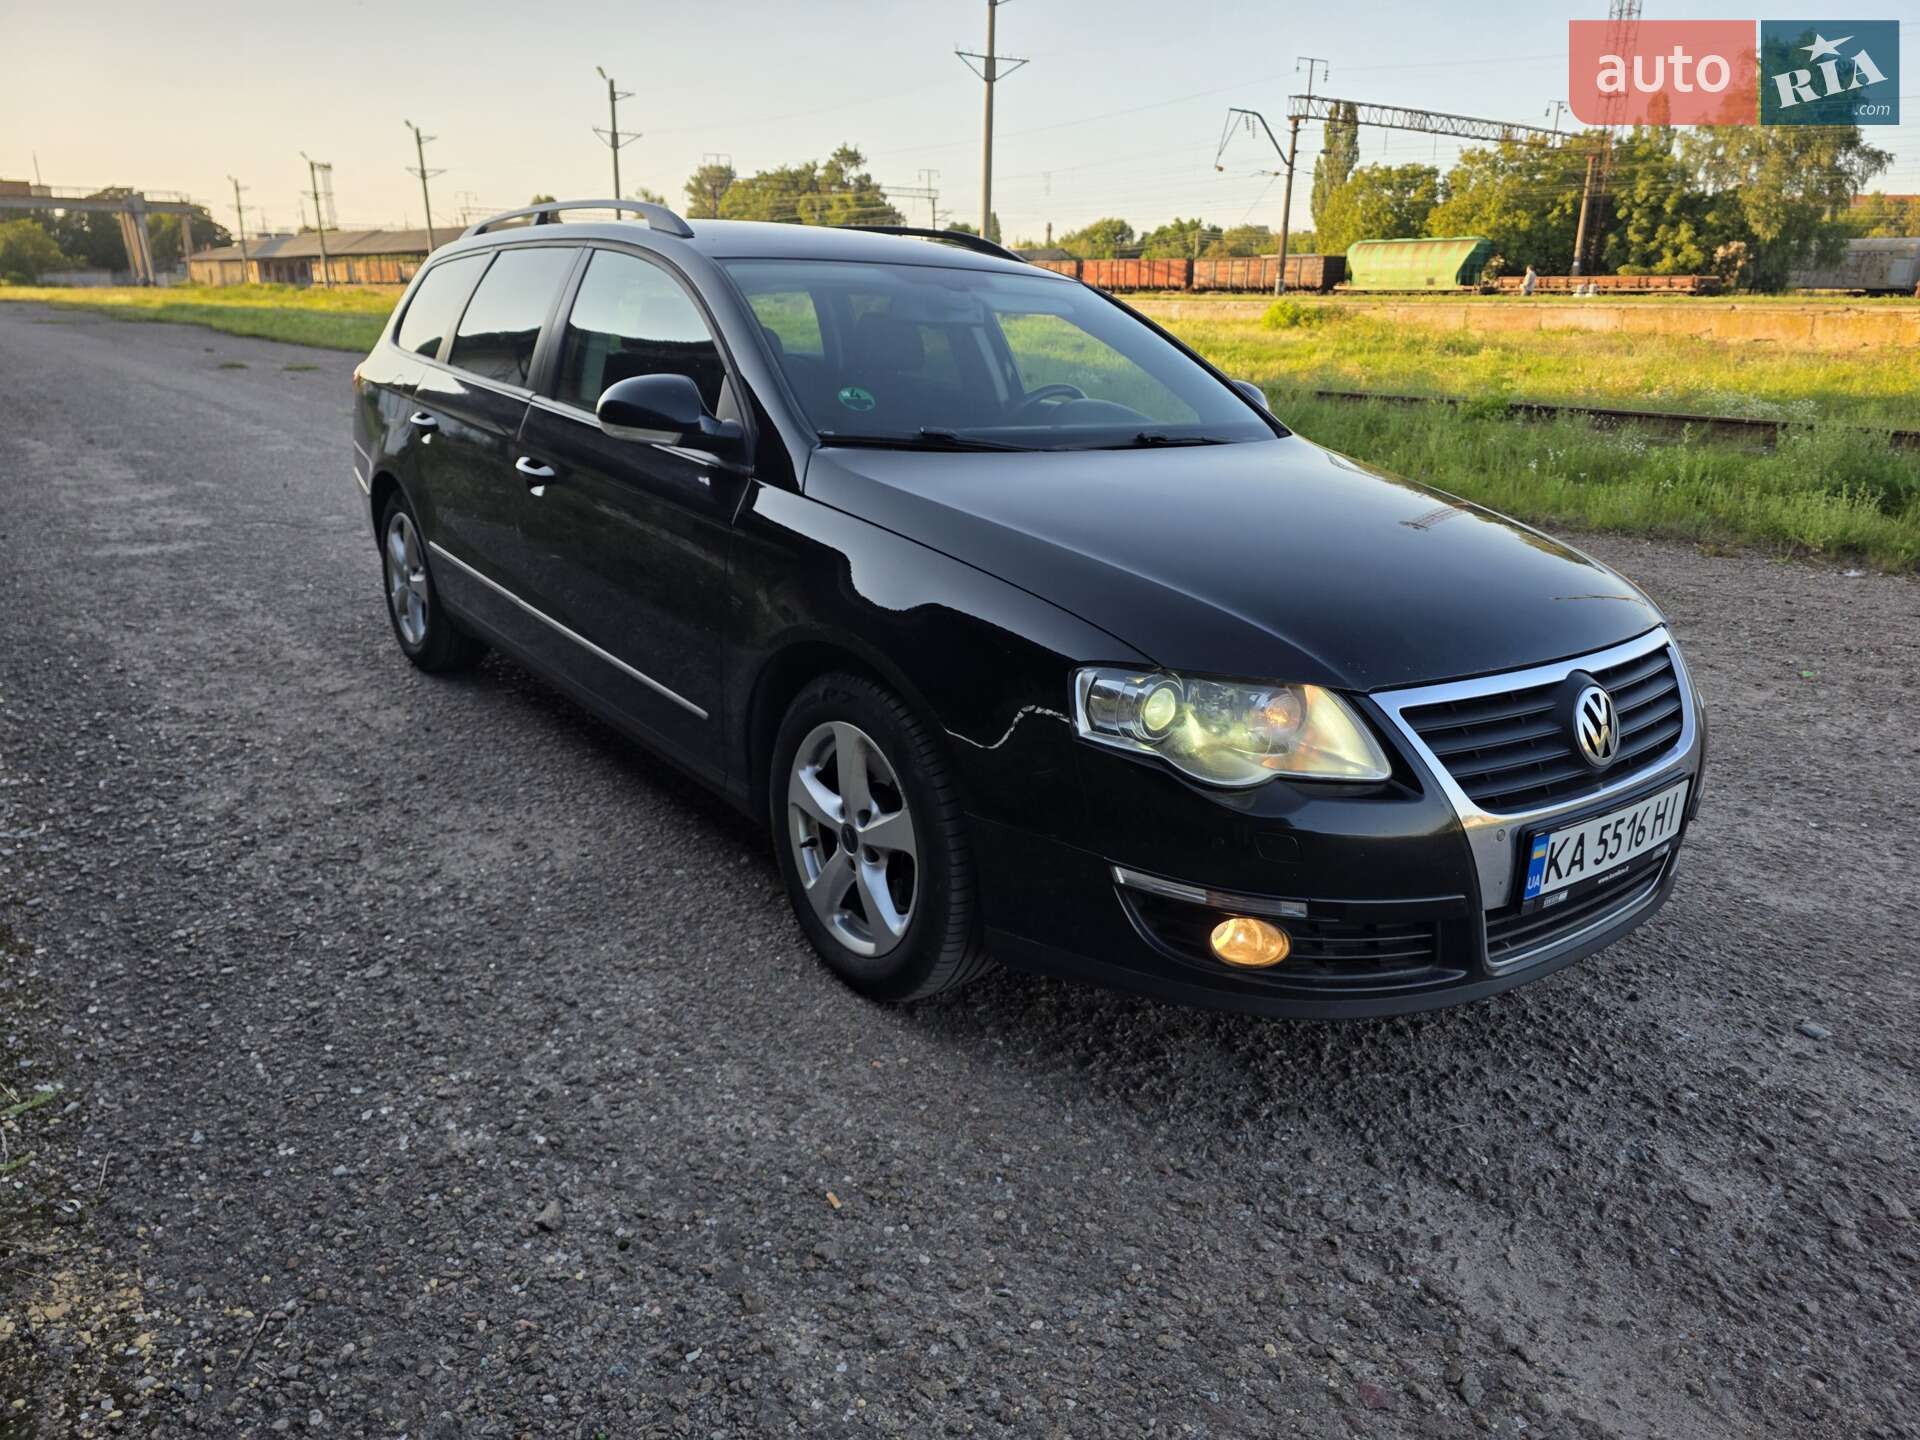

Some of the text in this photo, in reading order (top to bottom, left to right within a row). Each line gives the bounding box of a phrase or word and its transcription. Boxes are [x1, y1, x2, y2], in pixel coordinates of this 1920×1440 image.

[1544, 792, 1679, 885] KA 5516 HI
[1527, 875, 1541, 890] UA
